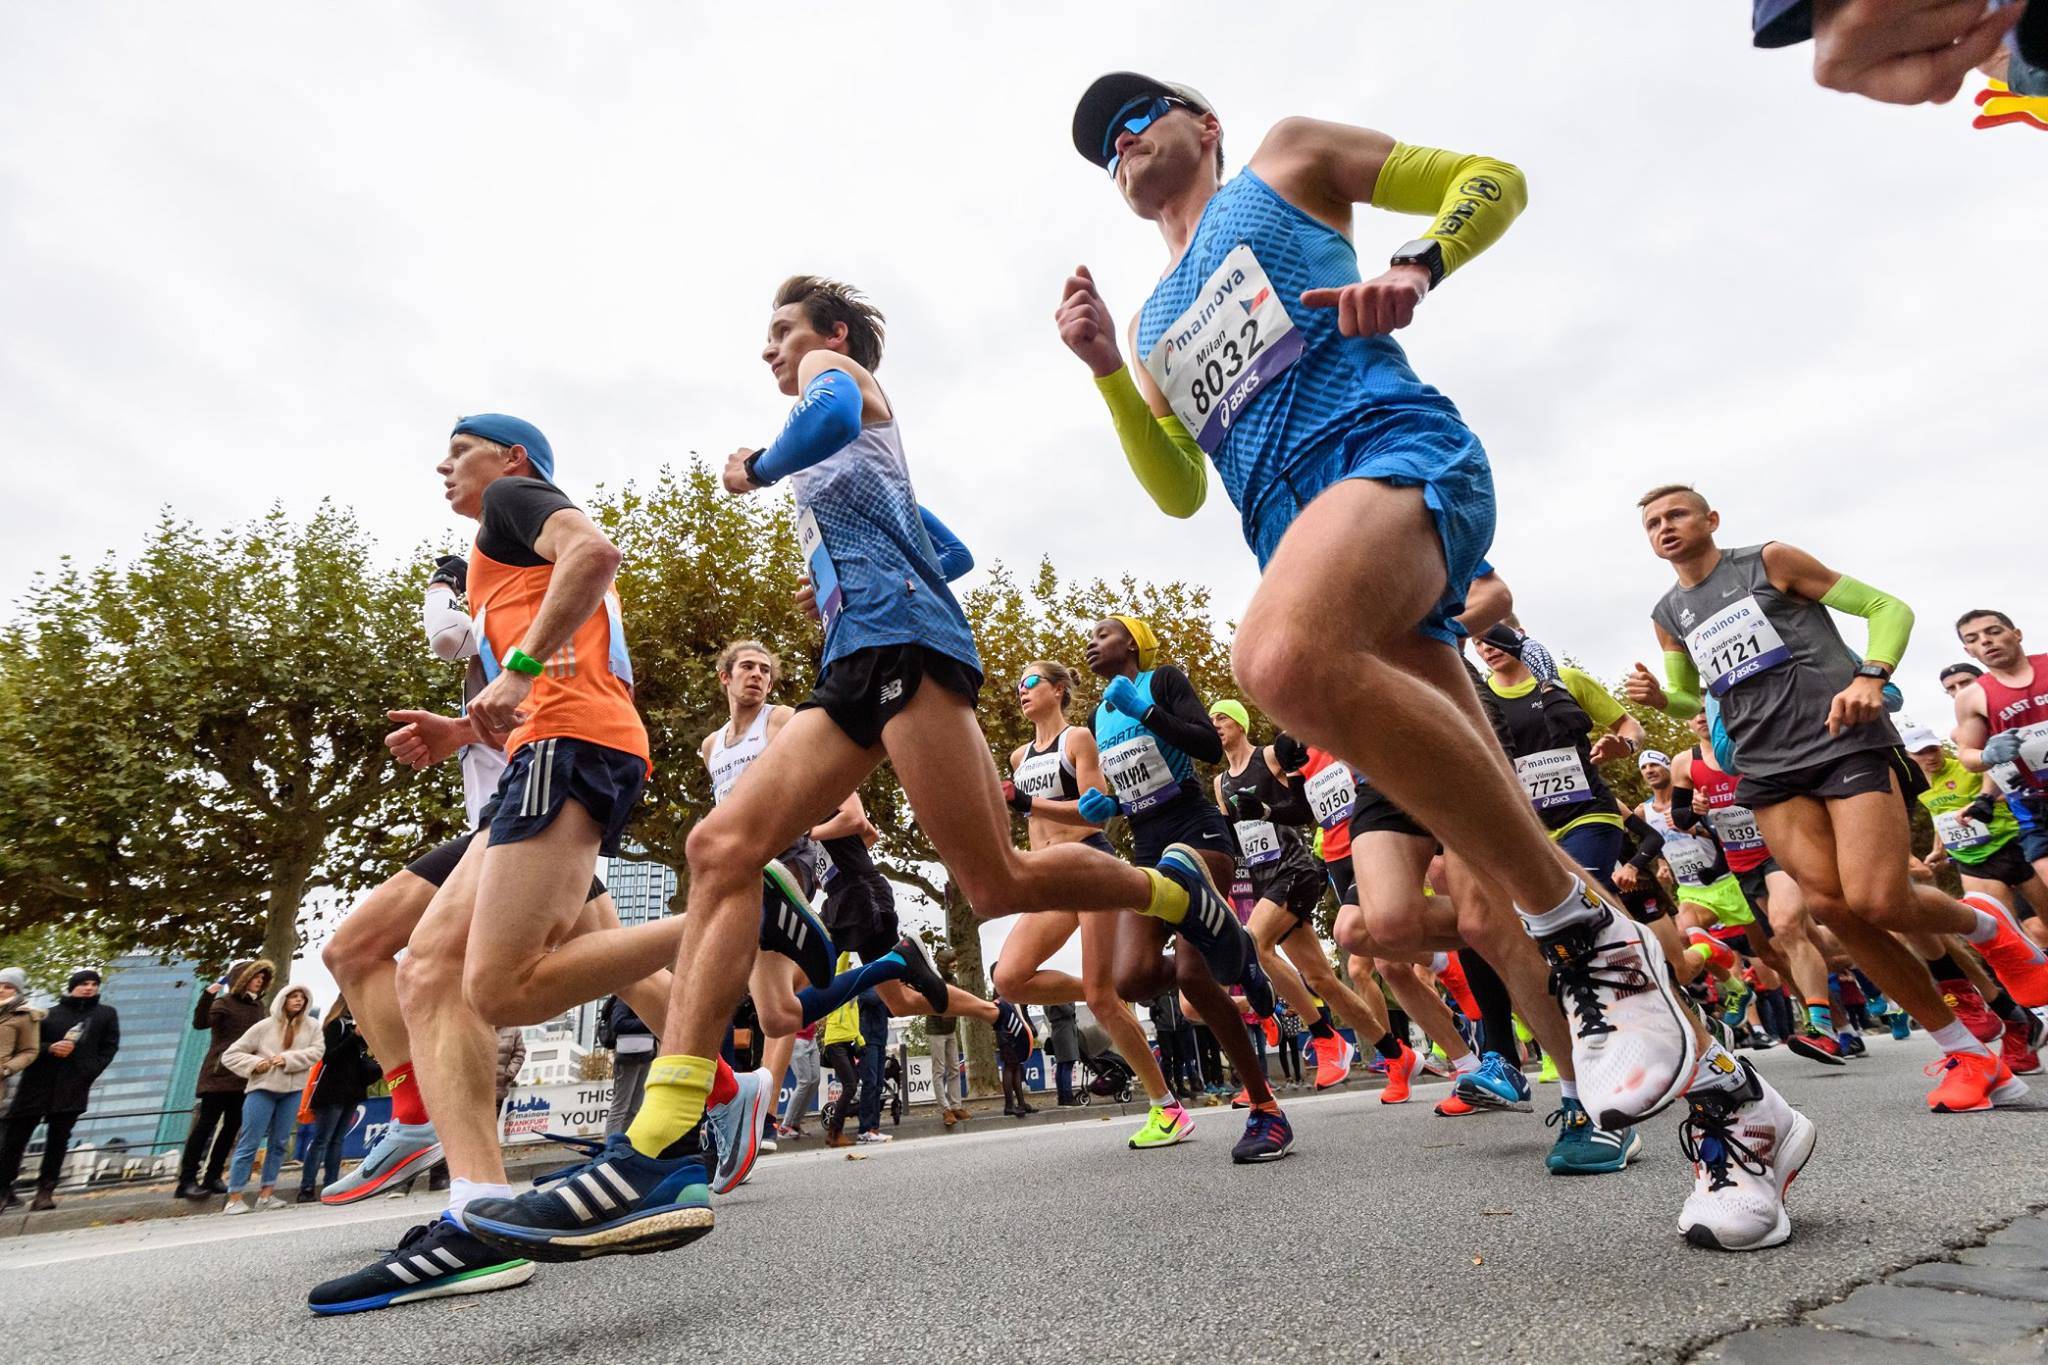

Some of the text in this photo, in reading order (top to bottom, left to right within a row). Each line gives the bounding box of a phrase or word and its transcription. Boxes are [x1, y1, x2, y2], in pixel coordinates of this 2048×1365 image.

[1175, 268, 1246, 351] mainova
[1196, 330, 1226, 367] Milan
[1191, 319, 1264, 415] 8032
[1229, 370, 1260, 411] asics
[1702, 608, 1750, 641] mainova
[1711, 632, 1742, 655] Andreas
[1711, 634, 1761, 675] 1121
[1737, 661, 1760, 679] asics
[1999, 699, 2031, 720] EAST
[1109, 744, 1149, 767] mainova
[1528, 754, 1572, 769] mainova
[1113, 762, 1151, 791] SYLVIA
[1314, 767, 1344, 789] mainova
[1529, 775, 1575, 797] 7725
[1709, 792, 1736, 804] ETTEN
[1716, 783, 1729, 792] LG
[1319, 788, 1350, 816] 9150
[1723, 809, 1750, 819] maino
[1948, 827, 1977, 841] 2631
[910, 1064, 921, 1075] IS
[577, 1089, 615, 1105] THIS
[909, 1081, 931, 1093] DAY
[504, 1118, 549, 1127] FRANKFURT
[516, 1111, 550, 1119] mainova
[504, 1125, 549, 1136] MARATHON
